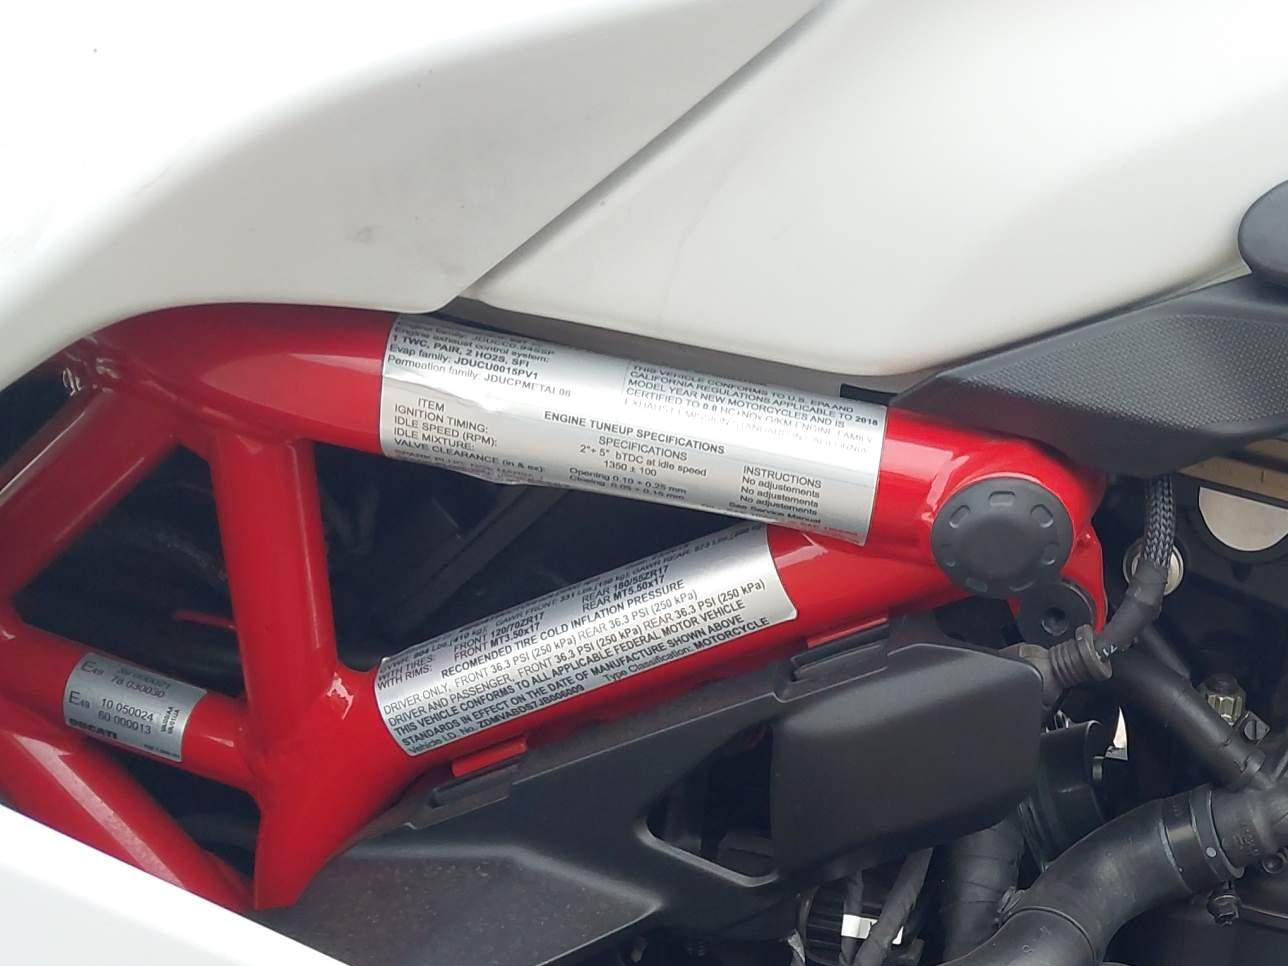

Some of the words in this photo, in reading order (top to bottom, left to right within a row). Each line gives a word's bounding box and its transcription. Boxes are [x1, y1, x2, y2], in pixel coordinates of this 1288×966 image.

[389, 344, 416, 357] Evap
[418, 348, 450, 364] family:
[393, 333, 397, 342] 1
[402, 336, 429, 348] TWC,
[475, 350, 508, 364] HO2S,
[511, 358, 529, 367] SFI
[475, 342, 509, 354] control
[387, 354, 445, 373] Permeation
[626, 387, 683, 405] CERTIFIED
[686, 400, 700, 408] TO
[628, 378, 666, 392] MODEL
[669, 386, 698, 399] YEAR
[700, 392, 726, 403] NEW
[728, 398, 808, 421] MOTORCYCLES
[809, 415, 832, 426] AND
[630, 371, 693, 389] CALIFORNIA
[696, 384, 771, 404] REGULATIONS
[771, 399, 837, 417] APPLICABLE
[660, 369, 705, 382] VEHICLE
[707, 378, 768, 396] CONFORMS
[771, 391, 785, 399] TO
[829, 403, 854, 413] AND
[418, 398, 445, 412] ITEM
[394, 403, 444, 423] IGNITION
[447, 416, 488, 434] TIMING:
[394, 416, 419, 429] IDLE
[422, 422, 460, 438] SPEED
[462, 430, 497, 447] (RPM):
[394, 427, 418, 440] IDLE
[421, 432, 475, 450] MIXTURE:
[544, 410, 586, 427] ENGINE
[589, 420, 634, 436] TUNEUP
[636, 429, 725, 455] SPECIFICATIONS
[394, 438, 429, 450] VALVE
[432, 445, 499, 464] CLEARANCE
[598, 436, 688, 461] SPECIFICATIONS
[569, 467, 610, 481] Opening
[604, 460, 628, 471] 1350
[640, 465, 657, 477] 100
[615, 450, 643, 464] bTDC
[646, 456, 655, 466] at
[658, 457, 675, 471] idle
[677, 464, 707, 477] speed
[742, 475, 756, 486] No
[758, 480, 820, 499] adjustements
[743, 465, 822, 489] INSTRUCTIONS
[739, 495, 754, 504] No
[755, 498, 817, 516] adjustements
[740, 486, 754, 496] No
[757, 489, 819, 508] adjustements
[377, 675, 403, 690] WITH
[405, 664, 432, 680] RIMS:
[454, 644, 488, 660] FRONT
[490, 622, 540, 646] MT3.50x17
[582, 597, 610, 612] REAR
[613, 575, 665, 600] MT5.50x17
[378, 667, 403, 682] WITH
[454, 635, 488, 652] FRONT
[491, 612, 544, 638] 120/70ZR17
[582, 588, 610, 602] REAR
[441, 645, 513, 678] RECOMENDED
[515, 635, 538, 650] TIRE
[540, 624, 569, 640] COLD
[571, 602, 625, 628] INFLATION
[626, 579, 685, 607] PRESSURE
[694, 617, 770, 649] MOTORCYCLE
[383, 694, 424, 715] DRIVER
[423, 683, 452, 698] ONLY,
[454, 668, 489, 687] FRONT
[492, 660, 512, 673] 36.3
[512, 651, 530, 665] PSI
[532, 644, 552, 660] (250
[554, 634, 577, 650] kPa)
[578, 622, 607, 640] REAR
[610, 614, 630, 628] 36.3
[632, 607, 650, 621] PSI
[651, 600, 672, 615] (250
[674, 589, 698, 604] kPa)
[387, 707, 428, 726] DRIVER
[428, 698, 448, 710] AND
[517, 658, 553, 677] FRONT
[554, 650, 576, 663] 36.3
[577, 642, 594, 656] PSI
[596, 633, 618, 650] (250
[620, 625, 642, 640] kPa)
[643, 612, 672, 630] REAR
[674, 604, 696, 620] 36.3
[698, 595, 716, 611] PSI
[718, 588, 740, 605] (250
[741, 578, 765, 595] kPa)
[394, 723, 417, 736] THIS
[420, 705, 458, 728] VEHICLE
[460, 684, 515, 712] CONFORMS
[515, 679, 530, 691] TO
[528, 670, 552, 683] ALL
[552, 646, 614, 678] APPLICABLE
[614, 632, 662, 655] FEDERAL
[661, 617, 700, 636] MOTOR
[700, 599, 745, 620] VEHICLE
[402, 718, 461, 746] STANDARDS
[462, 715, 473, 724] IN
[472, 701, 510, 720] EFFECT
[510, 694, 525, 705] ON
[525, 686, 547, 699] THE
[547, 676, 575, 692] DATE
[575, 670, 589, 681] OF
[591, 642, 667, 675] MANUFACTURE
[667, 627, 706, 647] SHOWN
[706, 614, 745, 633] ABOVE
[98, 710, 111, 721] 60
[113, 715, 152, 734] 000013
[101, 698, 114, 709] 10
[116, 703, 154, 721] 050024
